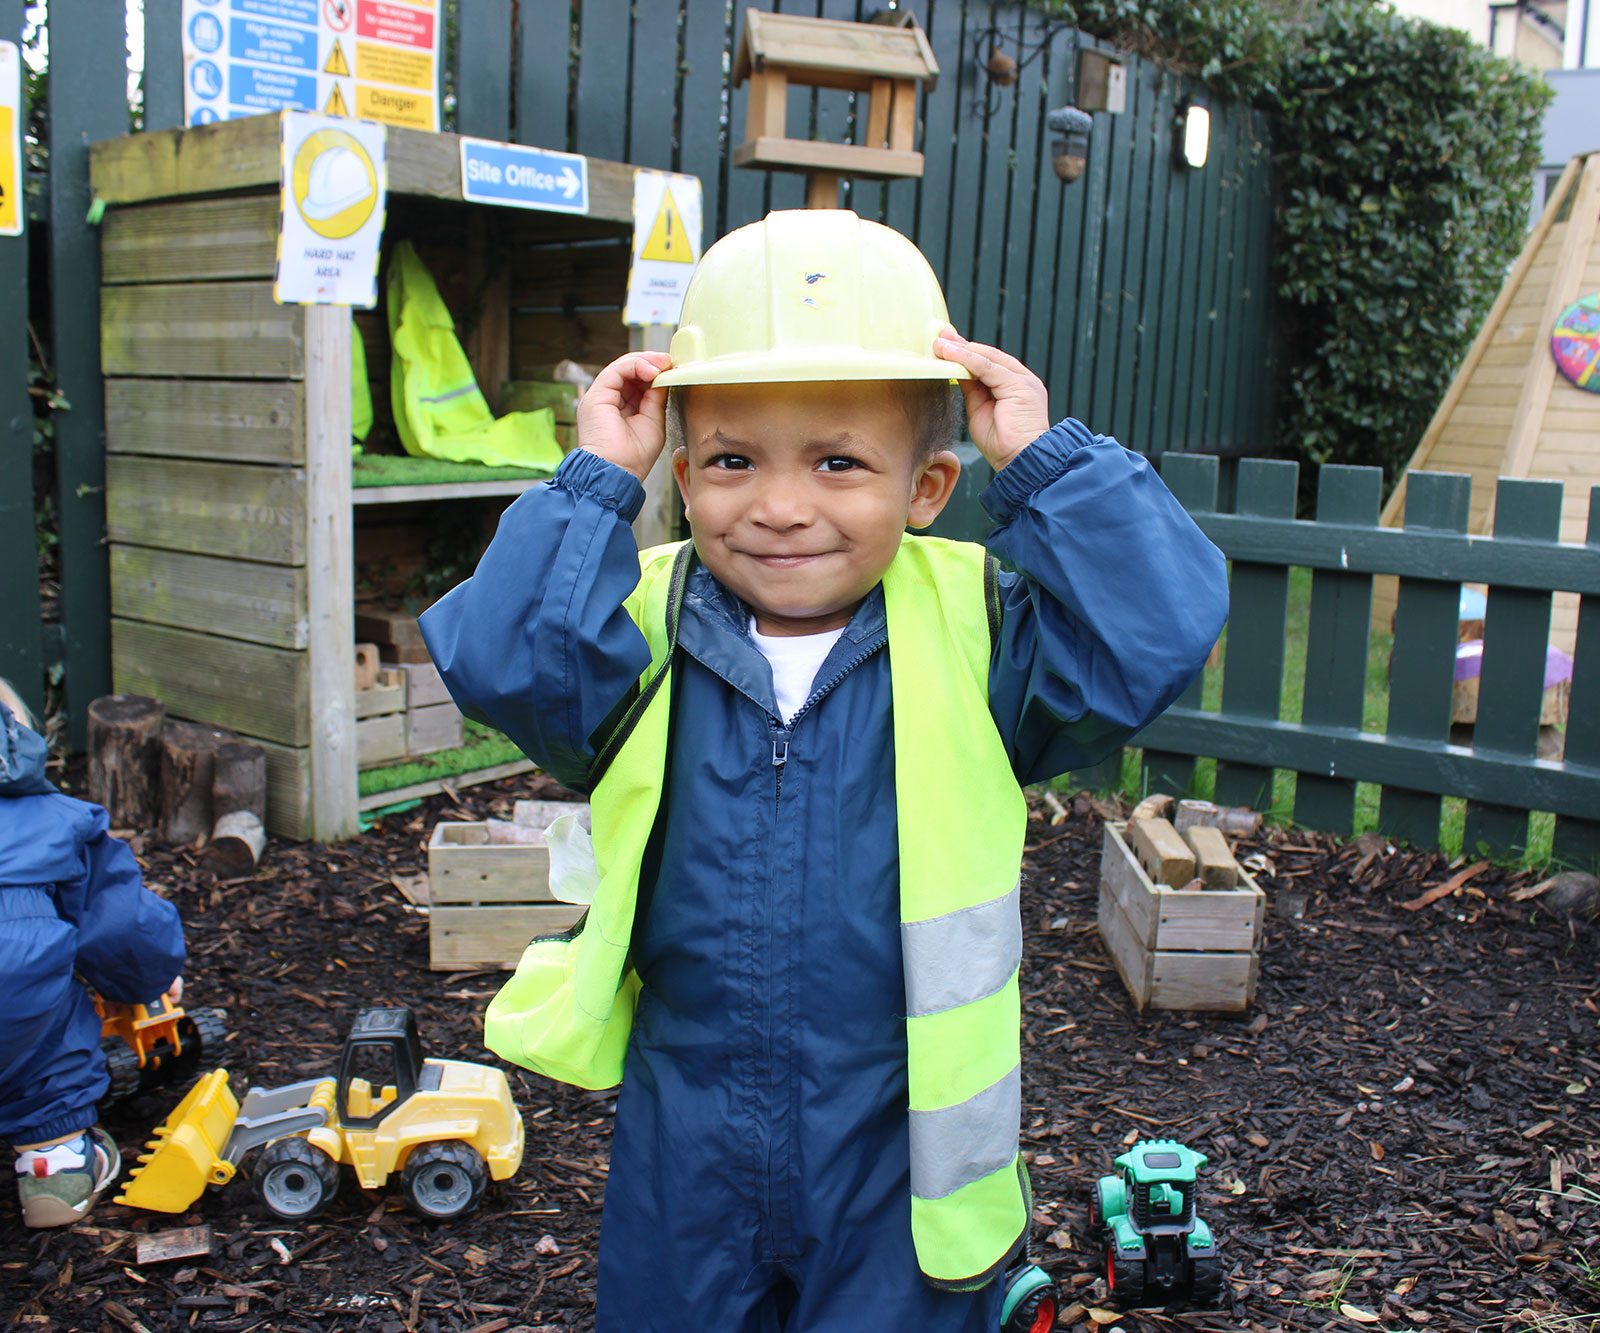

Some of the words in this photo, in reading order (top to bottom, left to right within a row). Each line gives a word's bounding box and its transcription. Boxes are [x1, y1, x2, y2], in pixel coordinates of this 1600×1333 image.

[245, 22, 268, 38] High
[269, 27, 305, 45] visibility
[252, 69, 298, 88] Protective
[370, 90, 417, 112] Danger
[467, 158, 502, 184] Site
[505, 164, 555, 192] Office
[304, 248, 333, 260] HARD
[336, 249, 356, 261] HAT
[314, 266, 340, 278] AREA
